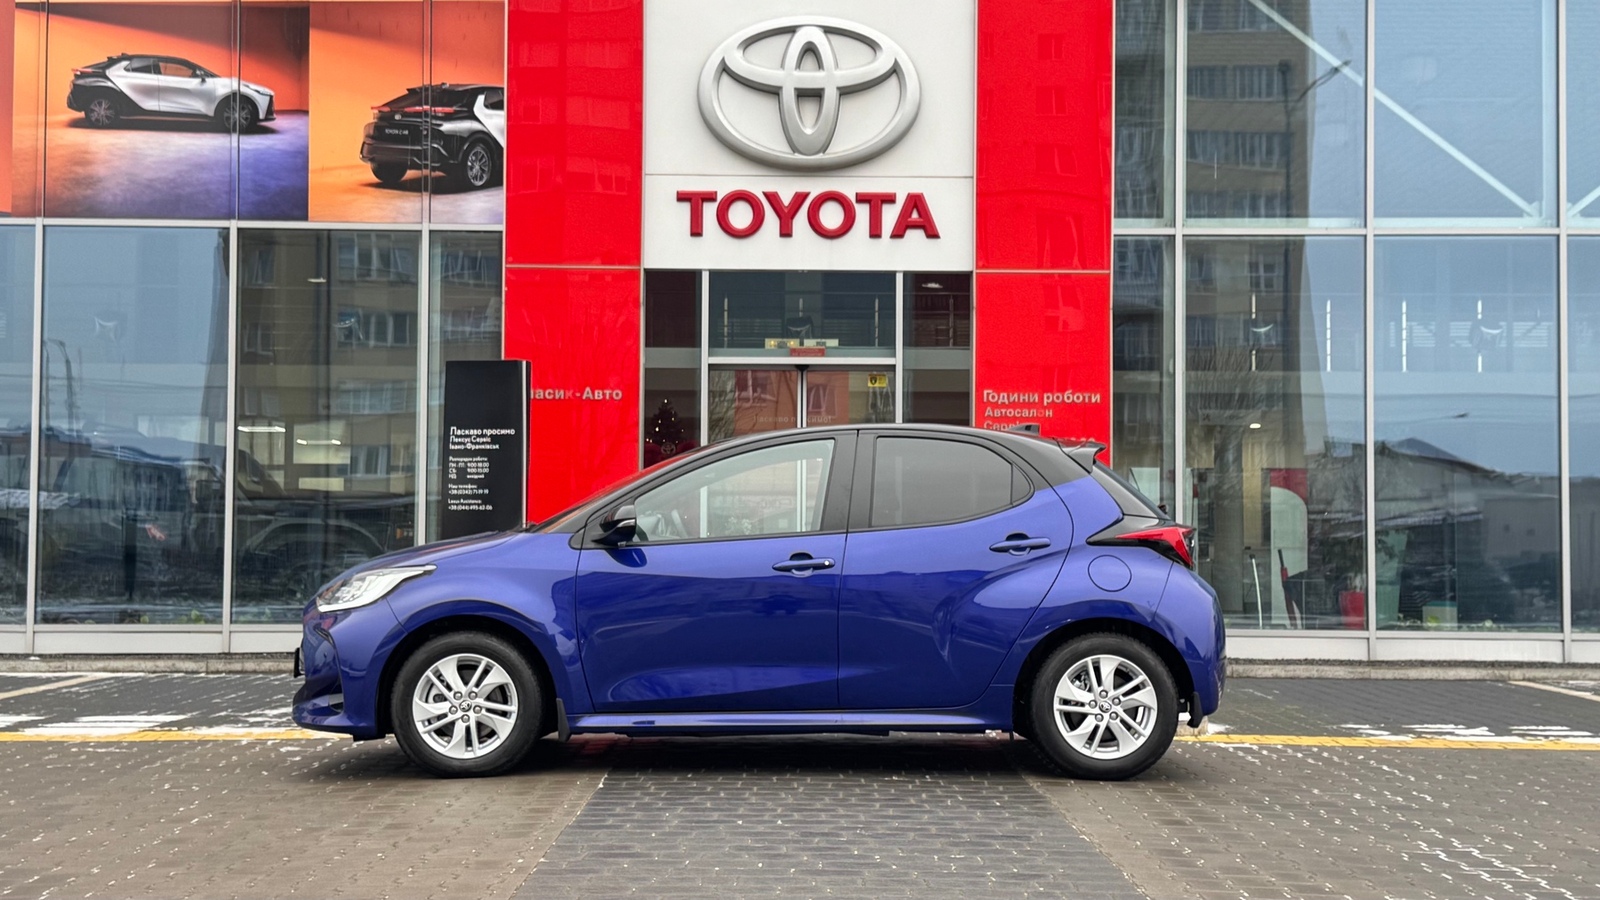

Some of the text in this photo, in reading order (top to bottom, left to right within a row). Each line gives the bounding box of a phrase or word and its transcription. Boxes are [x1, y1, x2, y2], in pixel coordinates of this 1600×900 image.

[676, 190, 941, 239] TOYOTA
[983, 389, 1101, 406] Години роботи
[984, 407, 1053, 418] Автосалон
